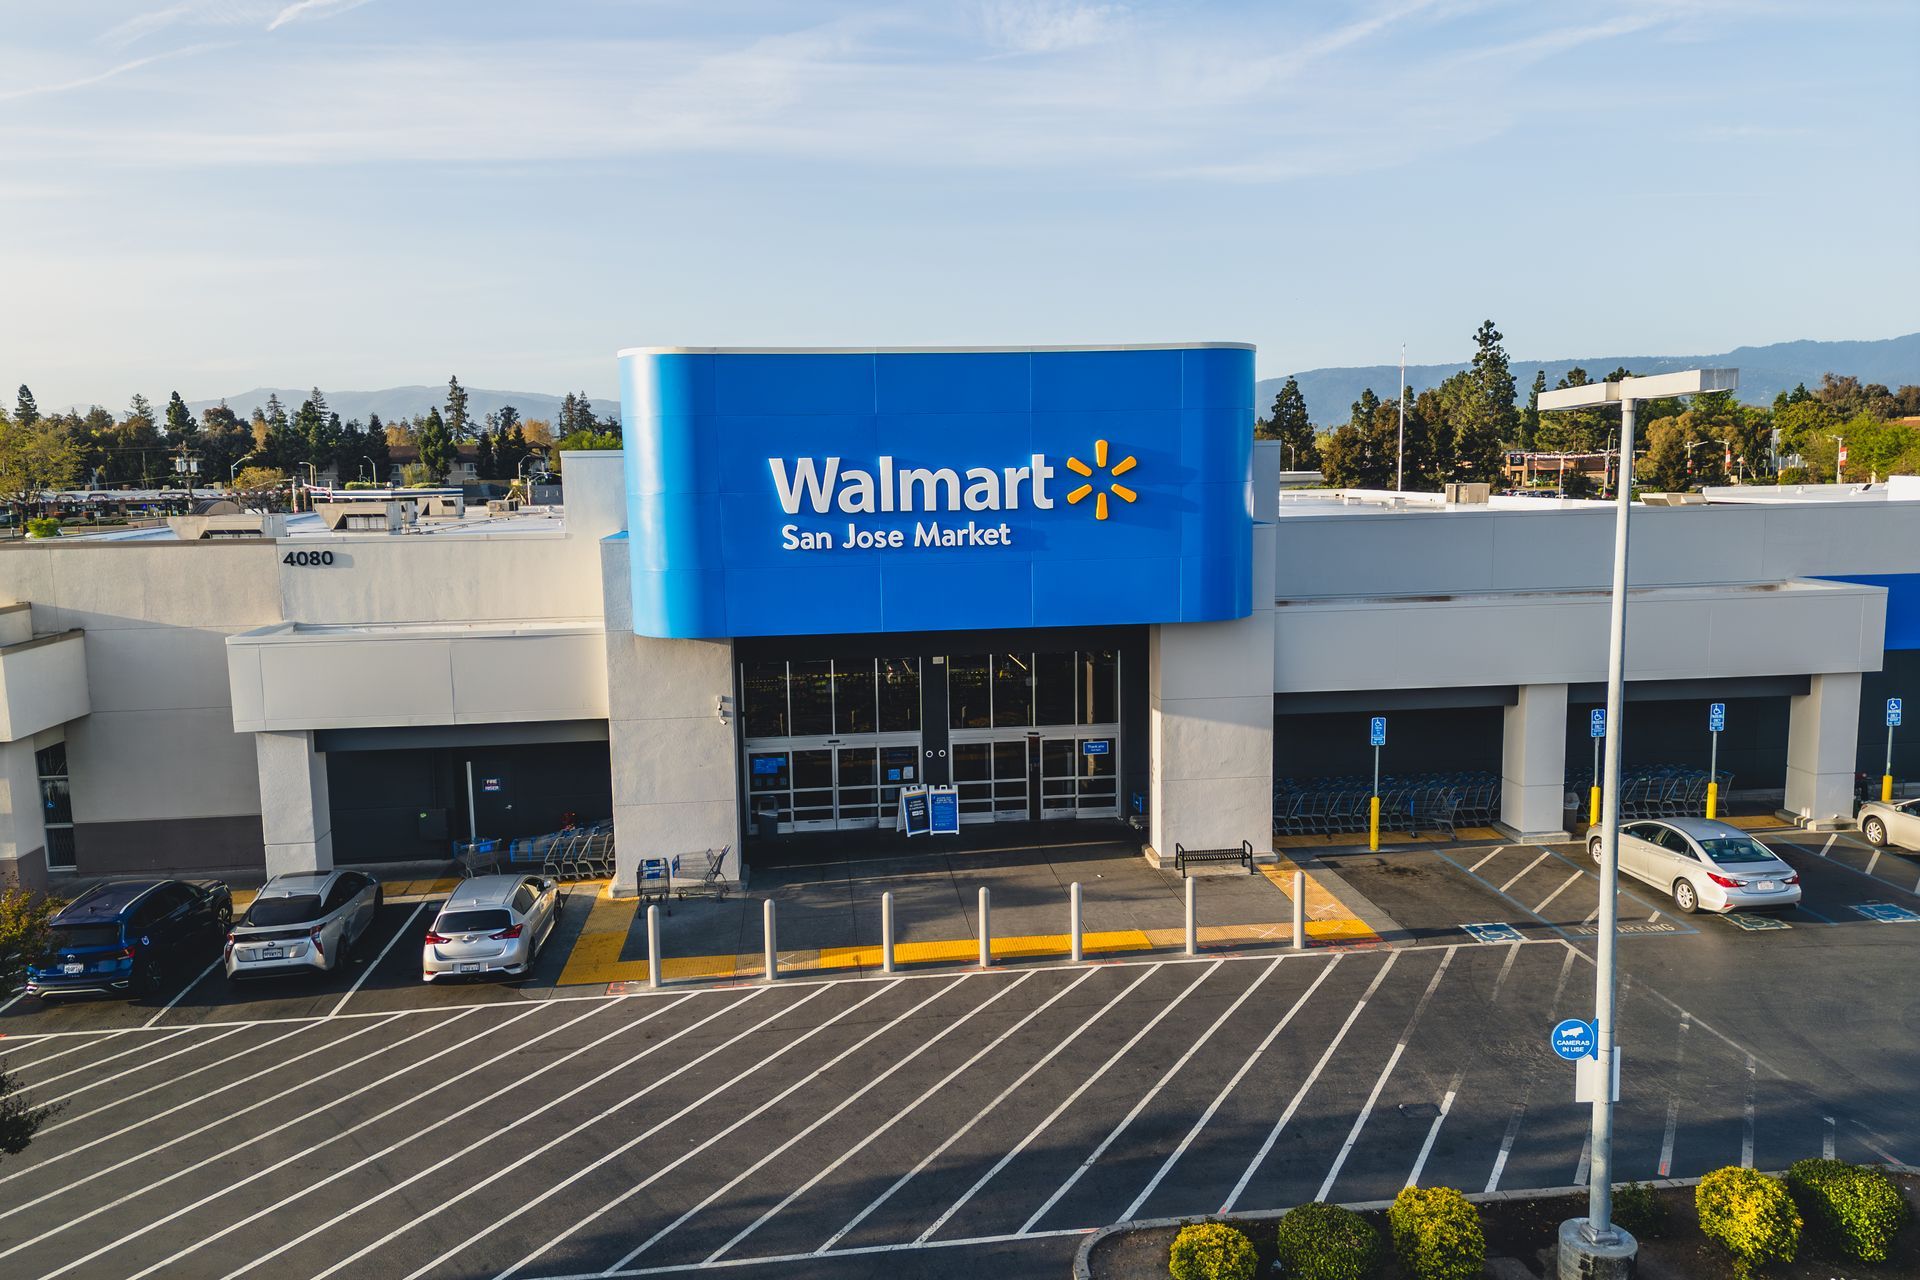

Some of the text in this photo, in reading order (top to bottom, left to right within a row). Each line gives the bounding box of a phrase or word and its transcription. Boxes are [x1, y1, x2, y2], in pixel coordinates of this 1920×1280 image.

[768, 453, 1054, 515] Walmart
[781, 521, 1011, 550] San Jose Market
[283, 550, 334, 566] 4080
[1616, 923, 1675, 933] ARKING
